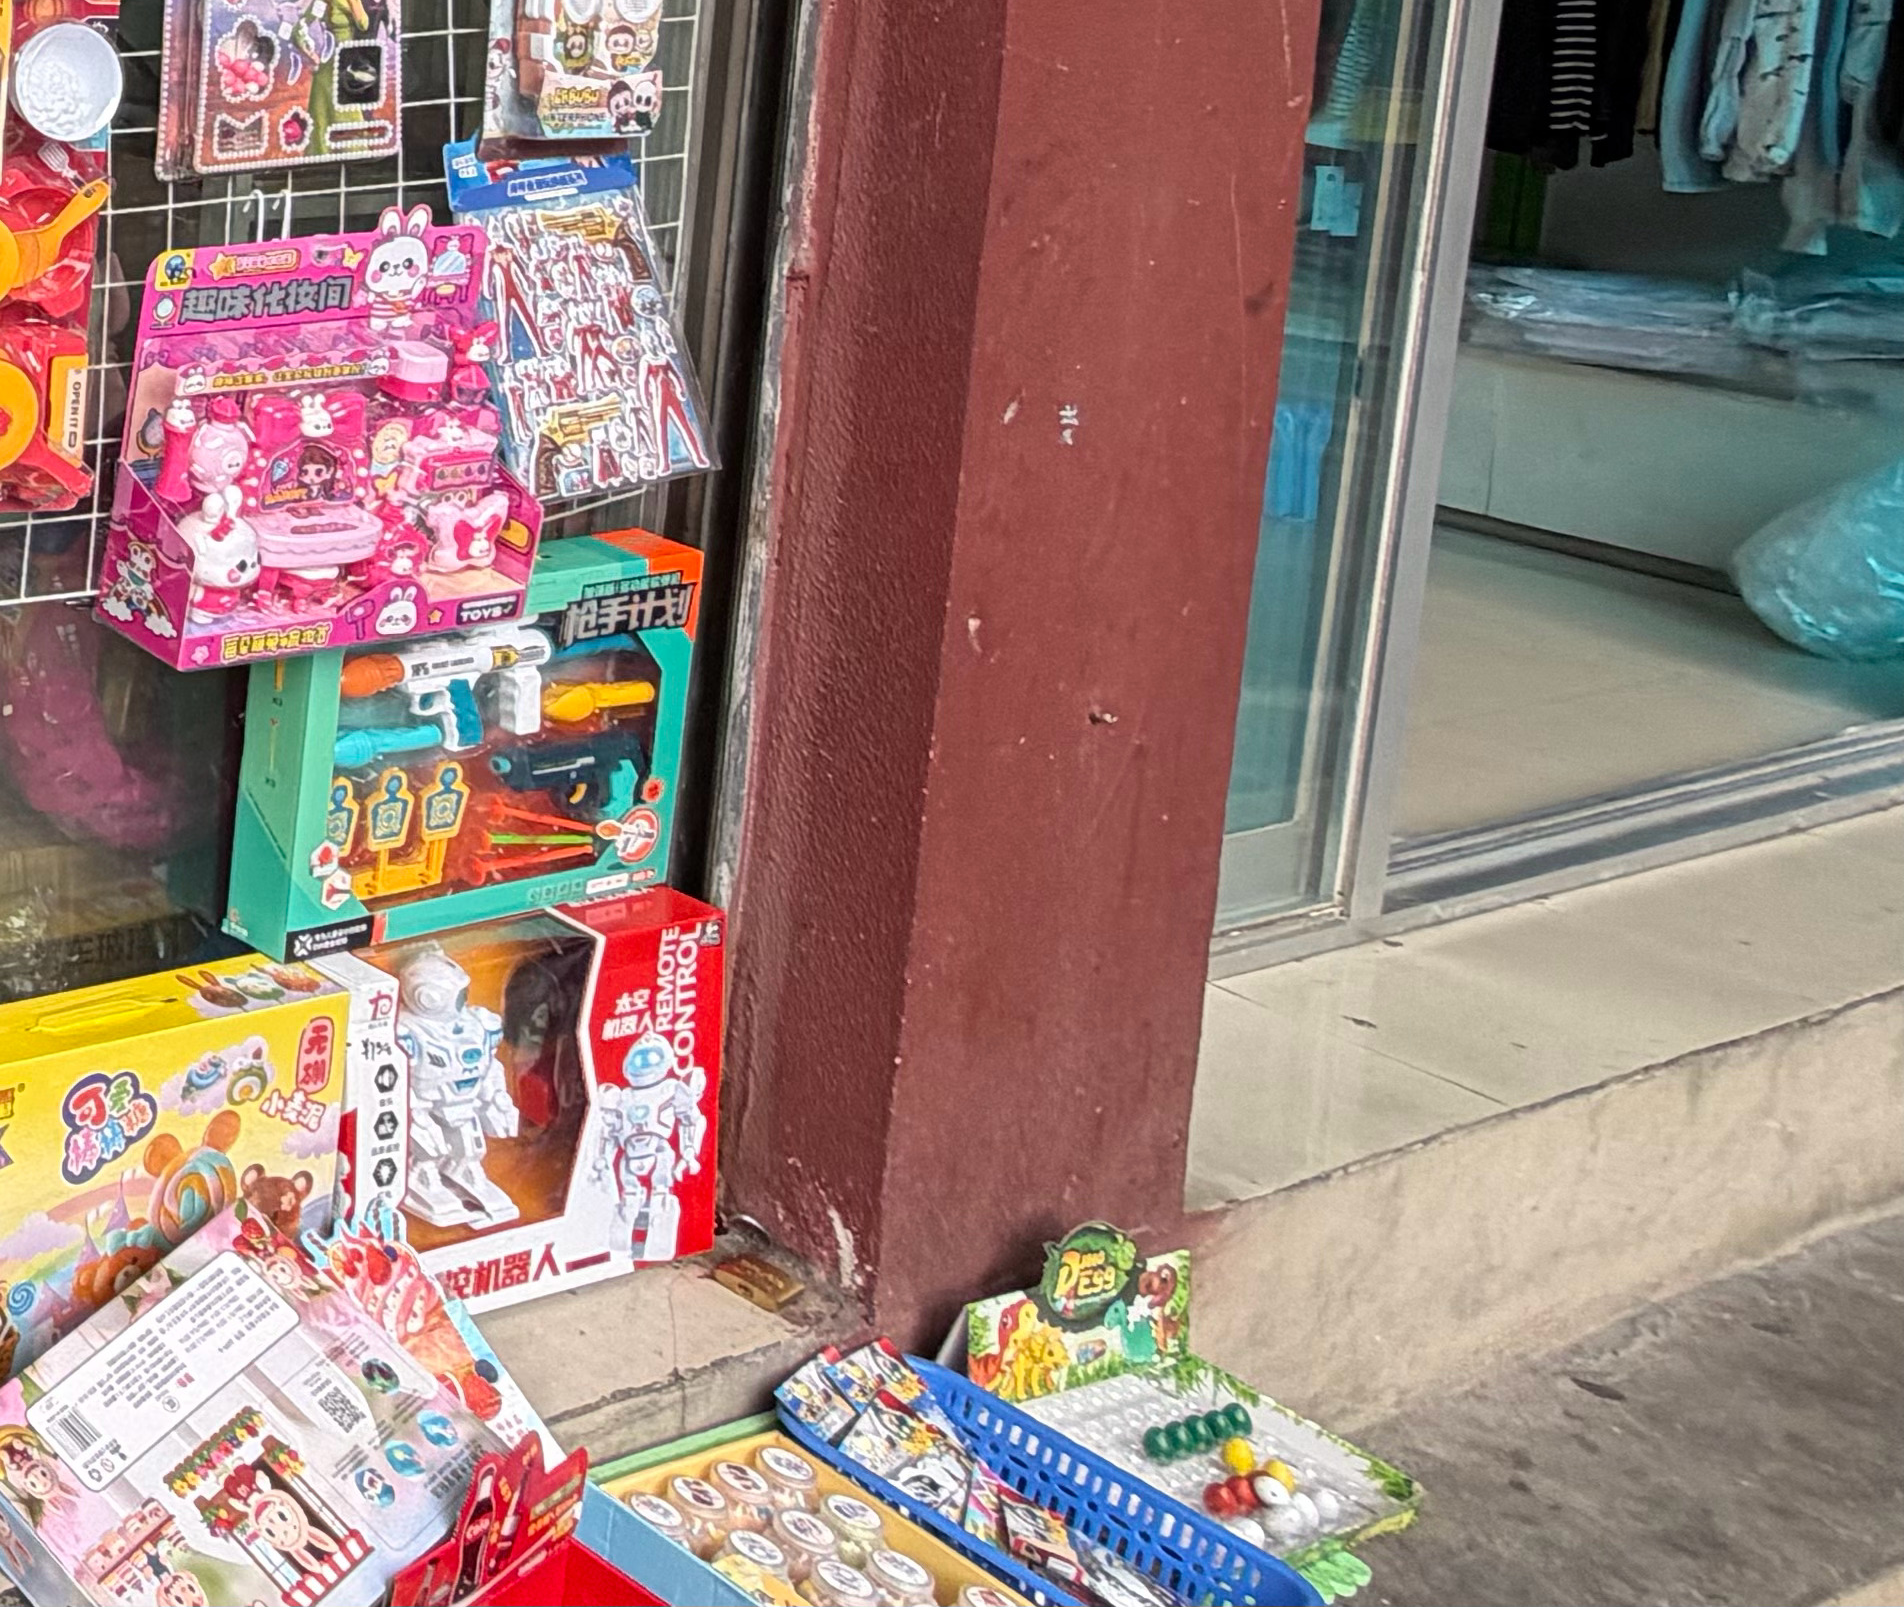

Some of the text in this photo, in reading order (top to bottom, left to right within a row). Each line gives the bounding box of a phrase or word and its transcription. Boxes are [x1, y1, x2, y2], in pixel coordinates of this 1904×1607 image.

[178, 276, 355, 324] 趣味化妆间
[70, 381, 82, 416] OPEN
[565, 584, 695, 648] 枪手计划
[656, 925, 680, 1032] REMOTE
[672, 923, 702, 1073] CONTROL
